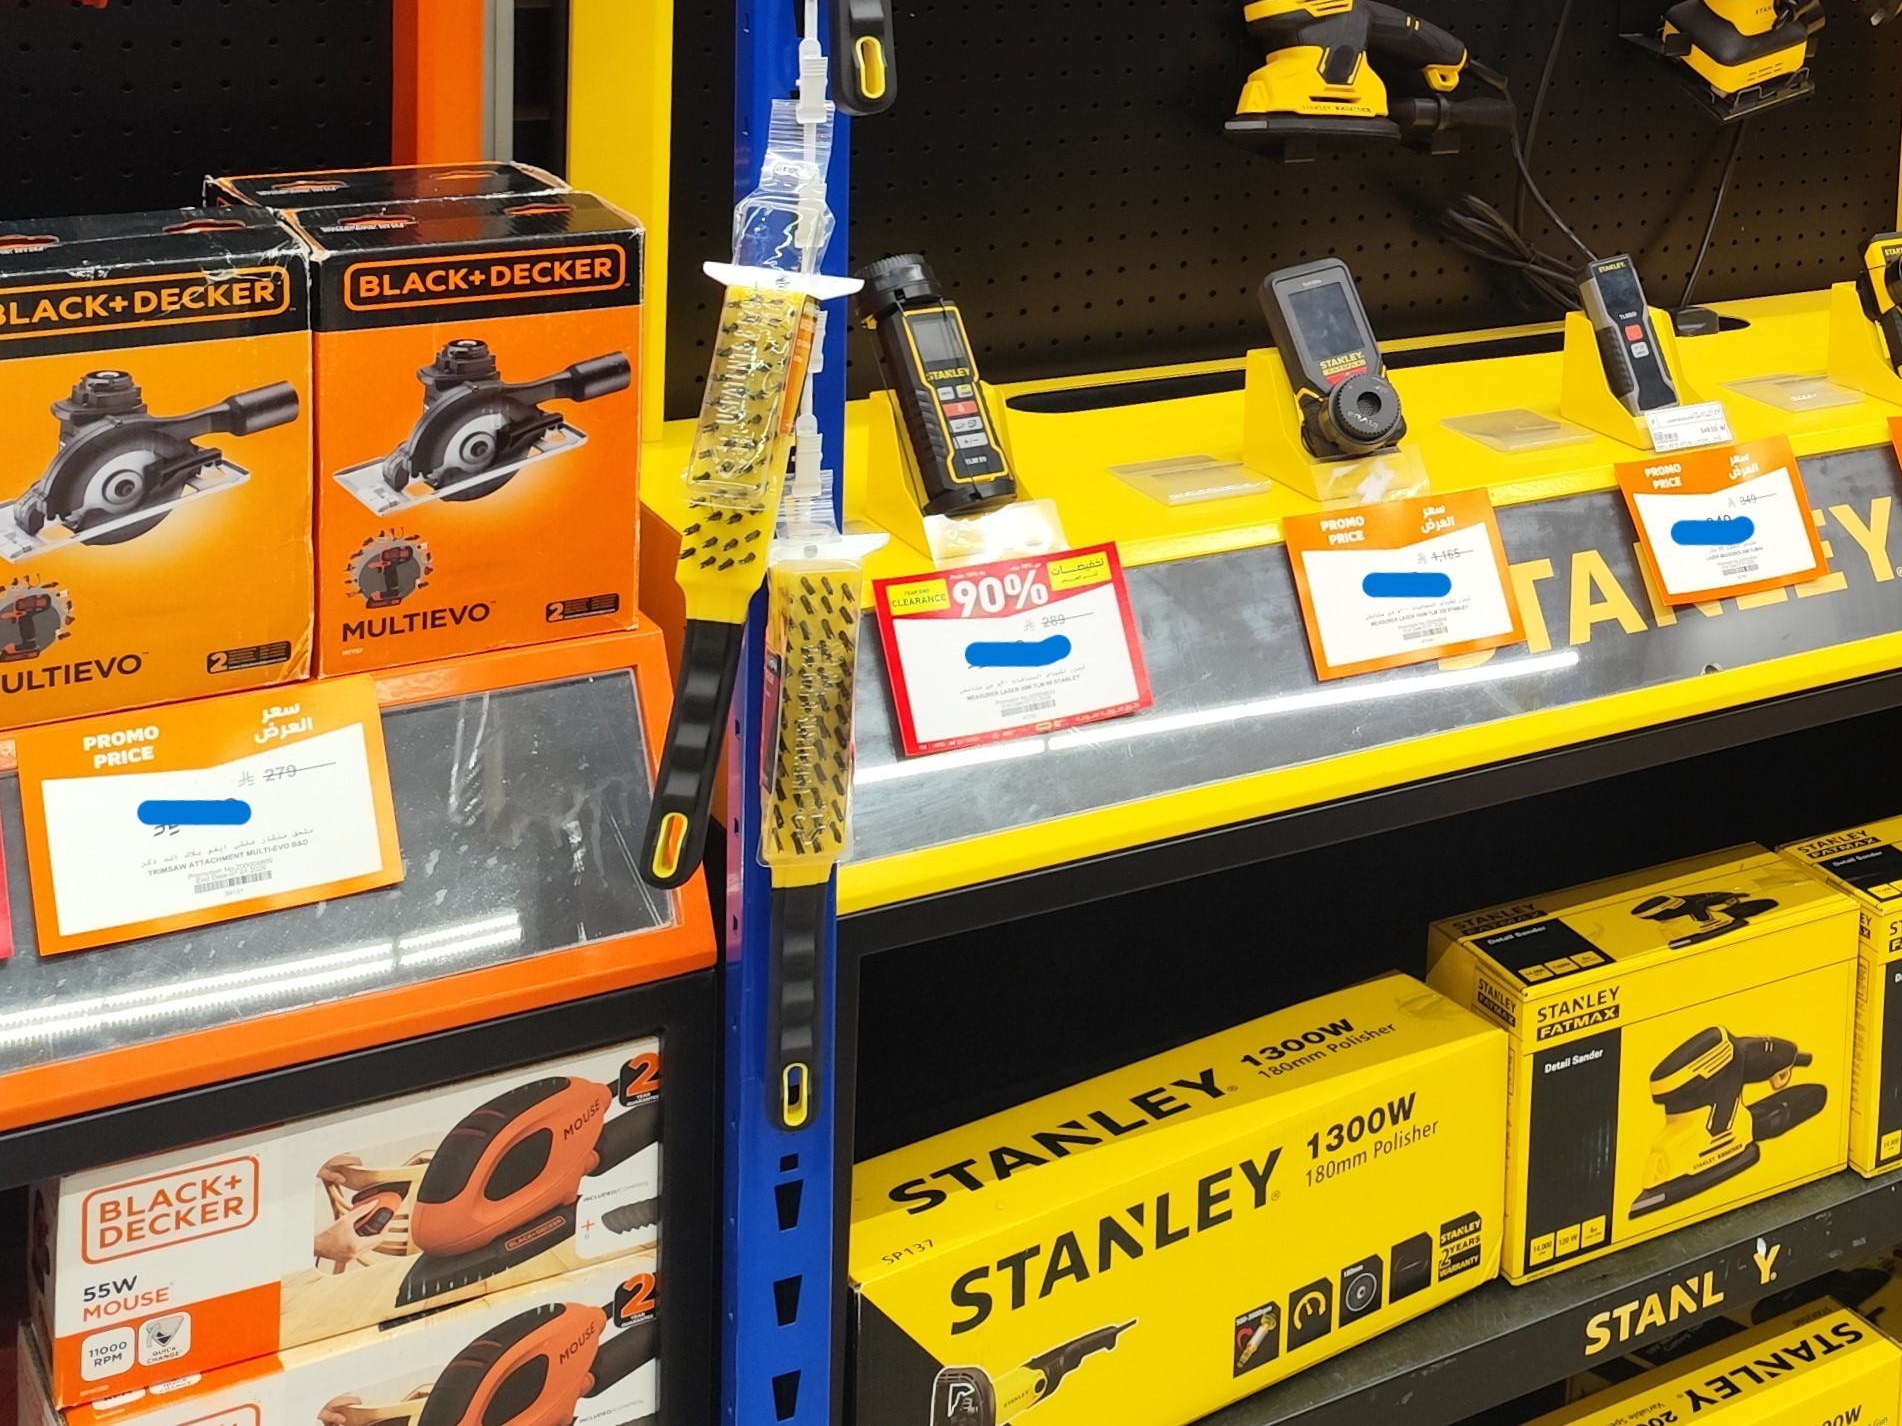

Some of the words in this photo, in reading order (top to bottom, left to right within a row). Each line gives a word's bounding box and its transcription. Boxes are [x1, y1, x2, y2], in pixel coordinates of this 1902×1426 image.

[359, 257, 613, 299] BLACK+DECKER
[1320, 351, 1362, 369] STANLEY
[1645, 464, 1682, 478] PROMO
[1729, 464, 1759, 480] العرض
[1730, 453, 1750, 466] سعر
[1653, 477, 1682, 490] PRICE
[1320, 516, 1365, 532] PROMO
[1423, 505, 1446, 518] سعر
[1329, 530, 1365, 545] PRICE
[1421, 516, 1455, 534] العرض
[892, 593, 947, 608] CLEARANCE
[952, 570, 1048, 617] 90%
[342, 601, 490, 643] MULTIEVO
[548, 601, 564, 623] 2
[1042, 614, 1066, 629] 289
[261, 703, 300, 723] سعر
[83, 725, 160, 751] PROMO
[253, 717, 313, 744] العرض
[94, 745, 154, 769] PRICE
[264, 764, 297, 783] 279
[1797, 829, 1869, 855] STANLEY
[147, 863, 187, 877] TRIMSAW
[189, 850, 244, 870] ATTACHMENT
[246, 842, 290, 857] MULTI-EVO
[291, 839, 309, 849] B&D
[1537, 986, 1620, 1023] STANLEY
[1258, 1050, 1324, 1081] 180mm
[1326, 1021, 1397, 1059] Polisher
[1544, 1057, 1571, 1074] Detail
[1572, 1048, 1604, 1065] Sander
[563, 1099, 601, 1142] MOUSE
[626, 1052, 661, 1097] 2
[889, 1068, 1226, 1216] STANLEY
[1240, 1017, 1355, 1067] 1300W
[1305, 1151, 1368, 1188] 180mm
[1373, 1117, 1439, 1161] Polisher
[100, 1175, 242, 1225] BLACK+
[99, 1196, 244, 1249] DECKER
[950, 1147, 1283, 1336] STANLEY
[1306, 1091, 1417, 1160] 1300W
[1440, 1219, 1481, 1244] STANLEY
[881, 1237, 935, 1267] SP137
[1439, 1248, 1451, 1268] 2
[1450, 1235, 1481, 1254] YEARS
[1439, 1254, 1479, 1278] WARRANTY
[83, 1275, 138, 1303] 55W
[83, 1287, 169, 1323] MOUSE
[559, 1321, 596, 1365] MOUSE
[621, 1273, 656, 1319] 2
[89, 1340, 128, 1358] 11000
[94, 1352, 122, 1367] RPM
[152, 1346, 177, 1358] QUICK
